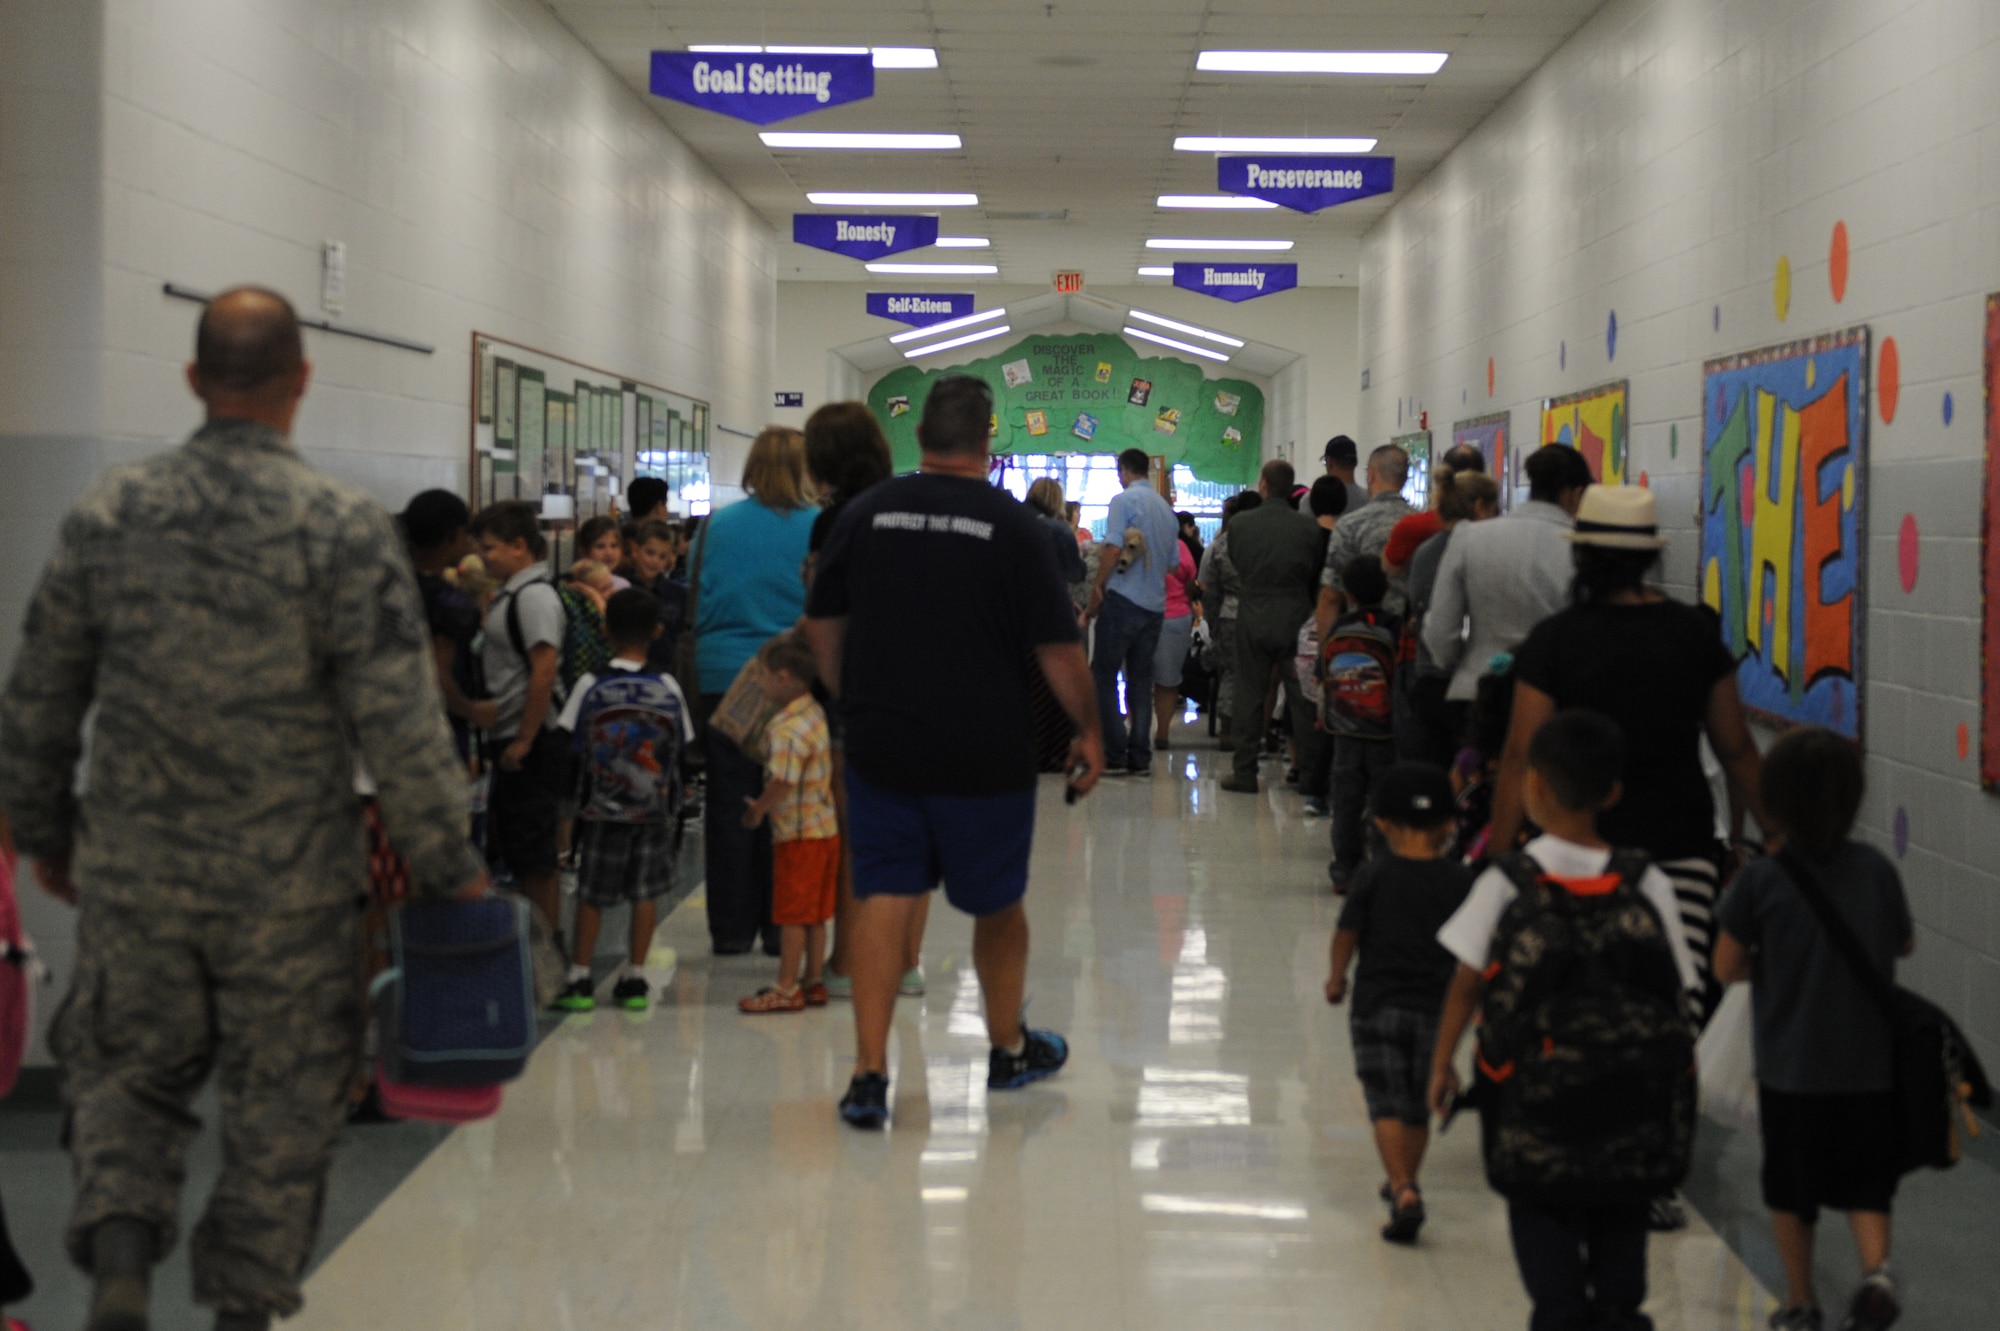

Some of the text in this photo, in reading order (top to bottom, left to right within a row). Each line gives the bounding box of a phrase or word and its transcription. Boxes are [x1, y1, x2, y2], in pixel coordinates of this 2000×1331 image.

[693, 61, 832, 102] Goal Setting
[1247, 164, 1363, 189] Perseverance
[836, 220, 896, 247] Honesty
[1057, 273, 1081, 292] EXIT
[1203, 268, 1266, 290] Humanity
[887, 297, 952, 313] Self-Esteem
[1033, 344, 1095, 355] DISCOVER
[1054, 355, 1077, 365] THE
[1042, 365, 1084, 375] MAGIC
[1048, 377, 1080, 387] OF A
[1025, 391, 1065, 401] GREAT
[1705, 368, 1853, 694] THE
